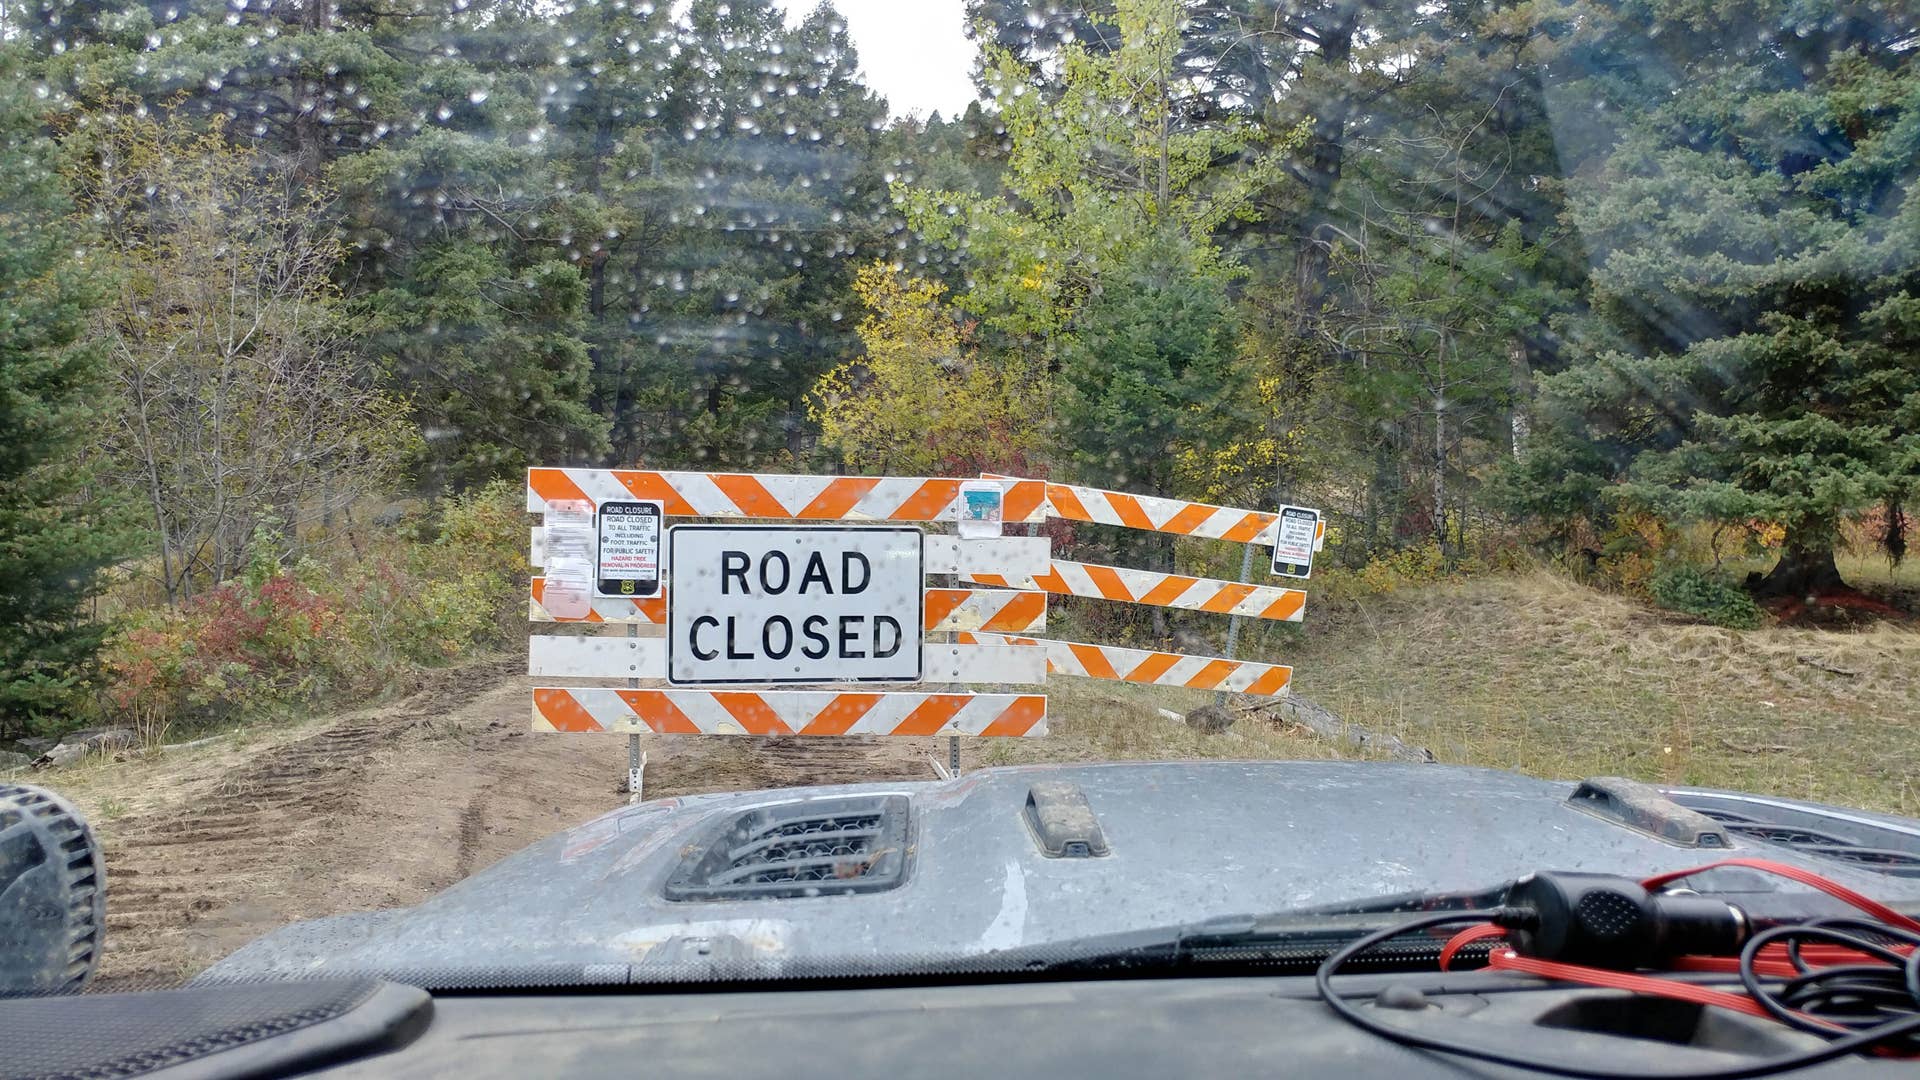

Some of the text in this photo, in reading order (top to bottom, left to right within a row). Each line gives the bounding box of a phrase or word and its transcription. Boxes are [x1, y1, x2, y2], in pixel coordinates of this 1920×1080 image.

[624, 506, 652, 514] CLOSURE
[721, 550, 872, 595] ROAD
[689, 614, 902, 661] CLOSED
